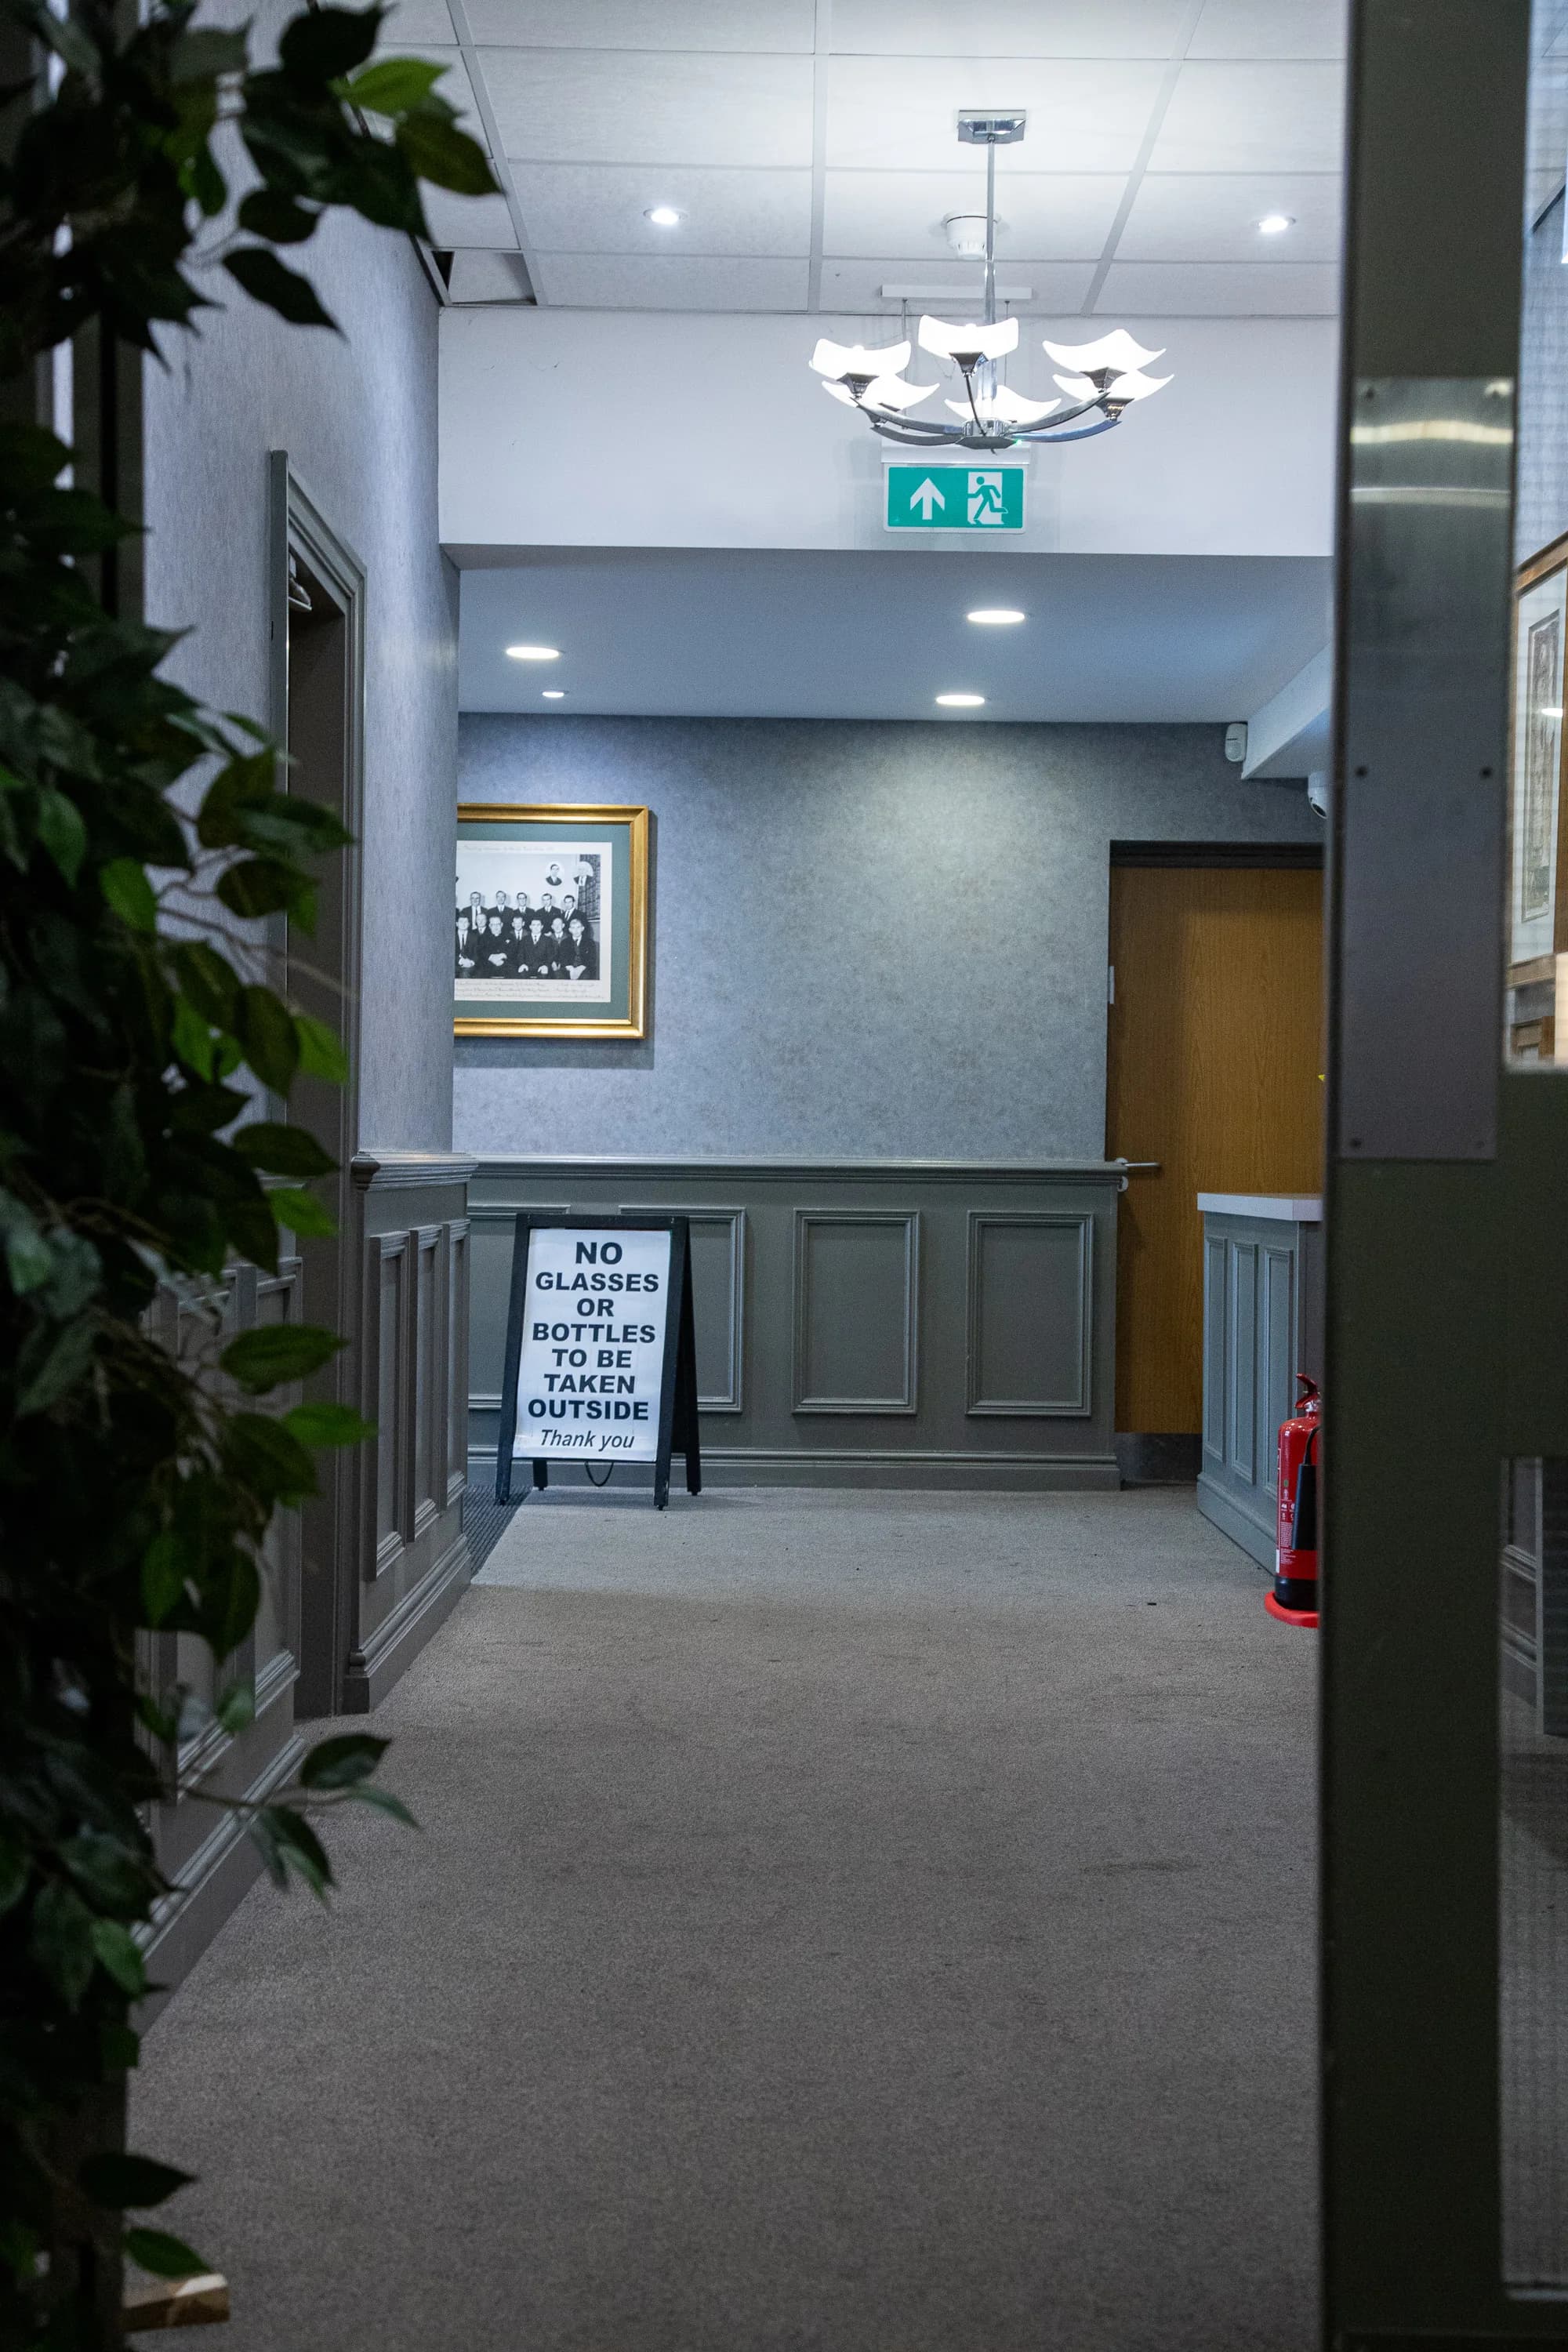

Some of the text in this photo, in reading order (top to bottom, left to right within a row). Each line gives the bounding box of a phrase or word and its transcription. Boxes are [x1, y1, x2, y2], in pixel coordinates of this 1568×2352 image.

[575, 1242, 622, 1265] NO
[535, 1272, 659, 1292] GLASSES
[576, 1298, 615, 1317] OR
[532, 1323, 655, 1343] BOTTLES
[551, 1348, 632, 1368] TO BE
[543, 1374, 635, 1394] TAKEN
[528, 1399, 649, 1421] OUTSIDE
[539, 1429, 635, 1452] Thank you
